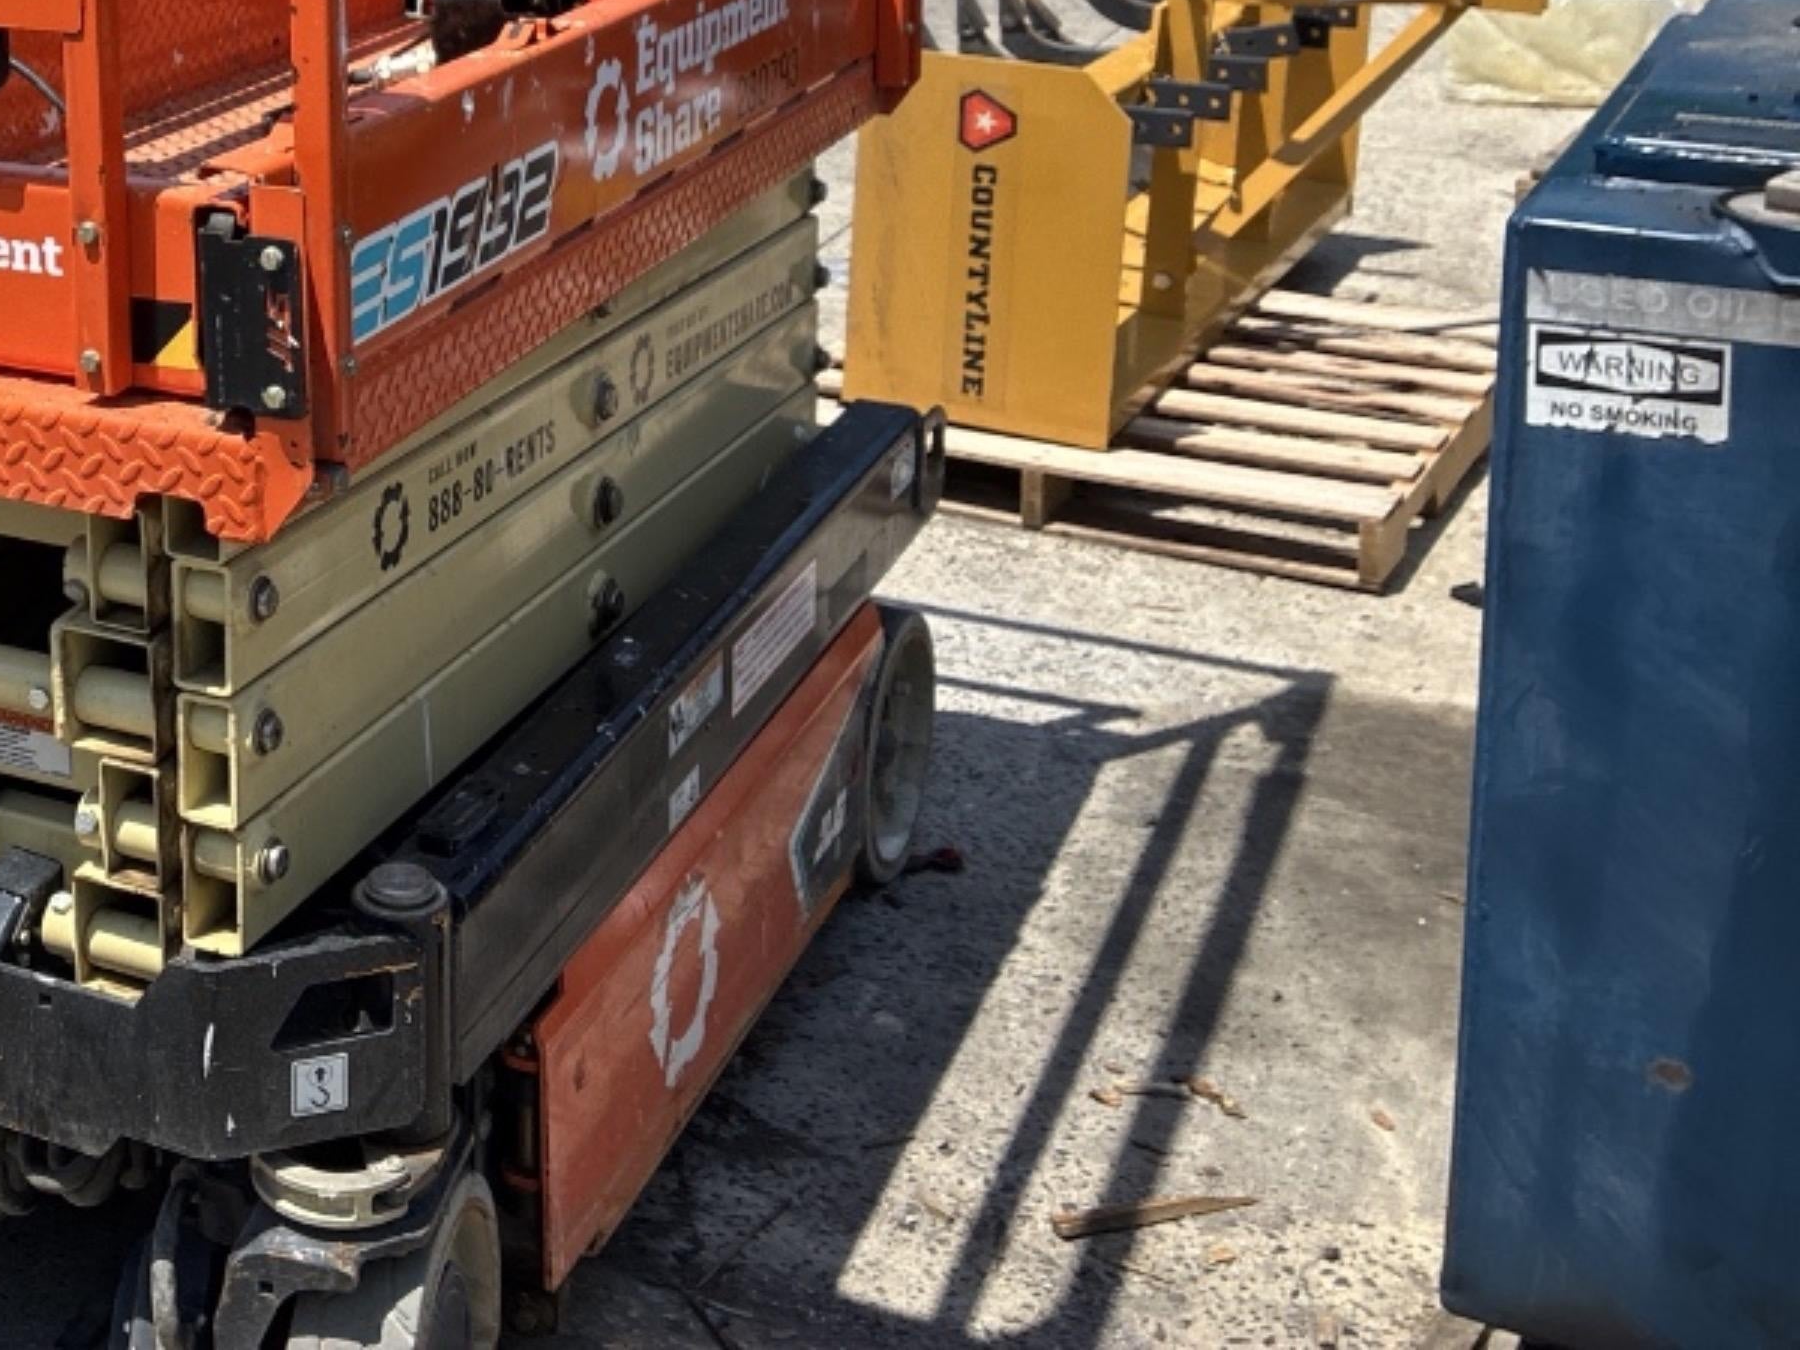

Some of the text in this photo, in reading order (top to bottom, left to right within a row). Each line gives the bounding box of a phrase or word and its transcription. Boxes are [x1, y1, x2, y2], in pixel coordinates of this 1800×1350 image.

[634, 85, 721, 176] Share
[352, 141, 558, 345] ES1932
[961, 164, 997, 397] COUNTYLINE
[1551, 400, 1698, 432] NO SMOKING
[1557, 349, 1701, 385] WARNING
[427, 418, 556, 532] 888-80-RENTS
